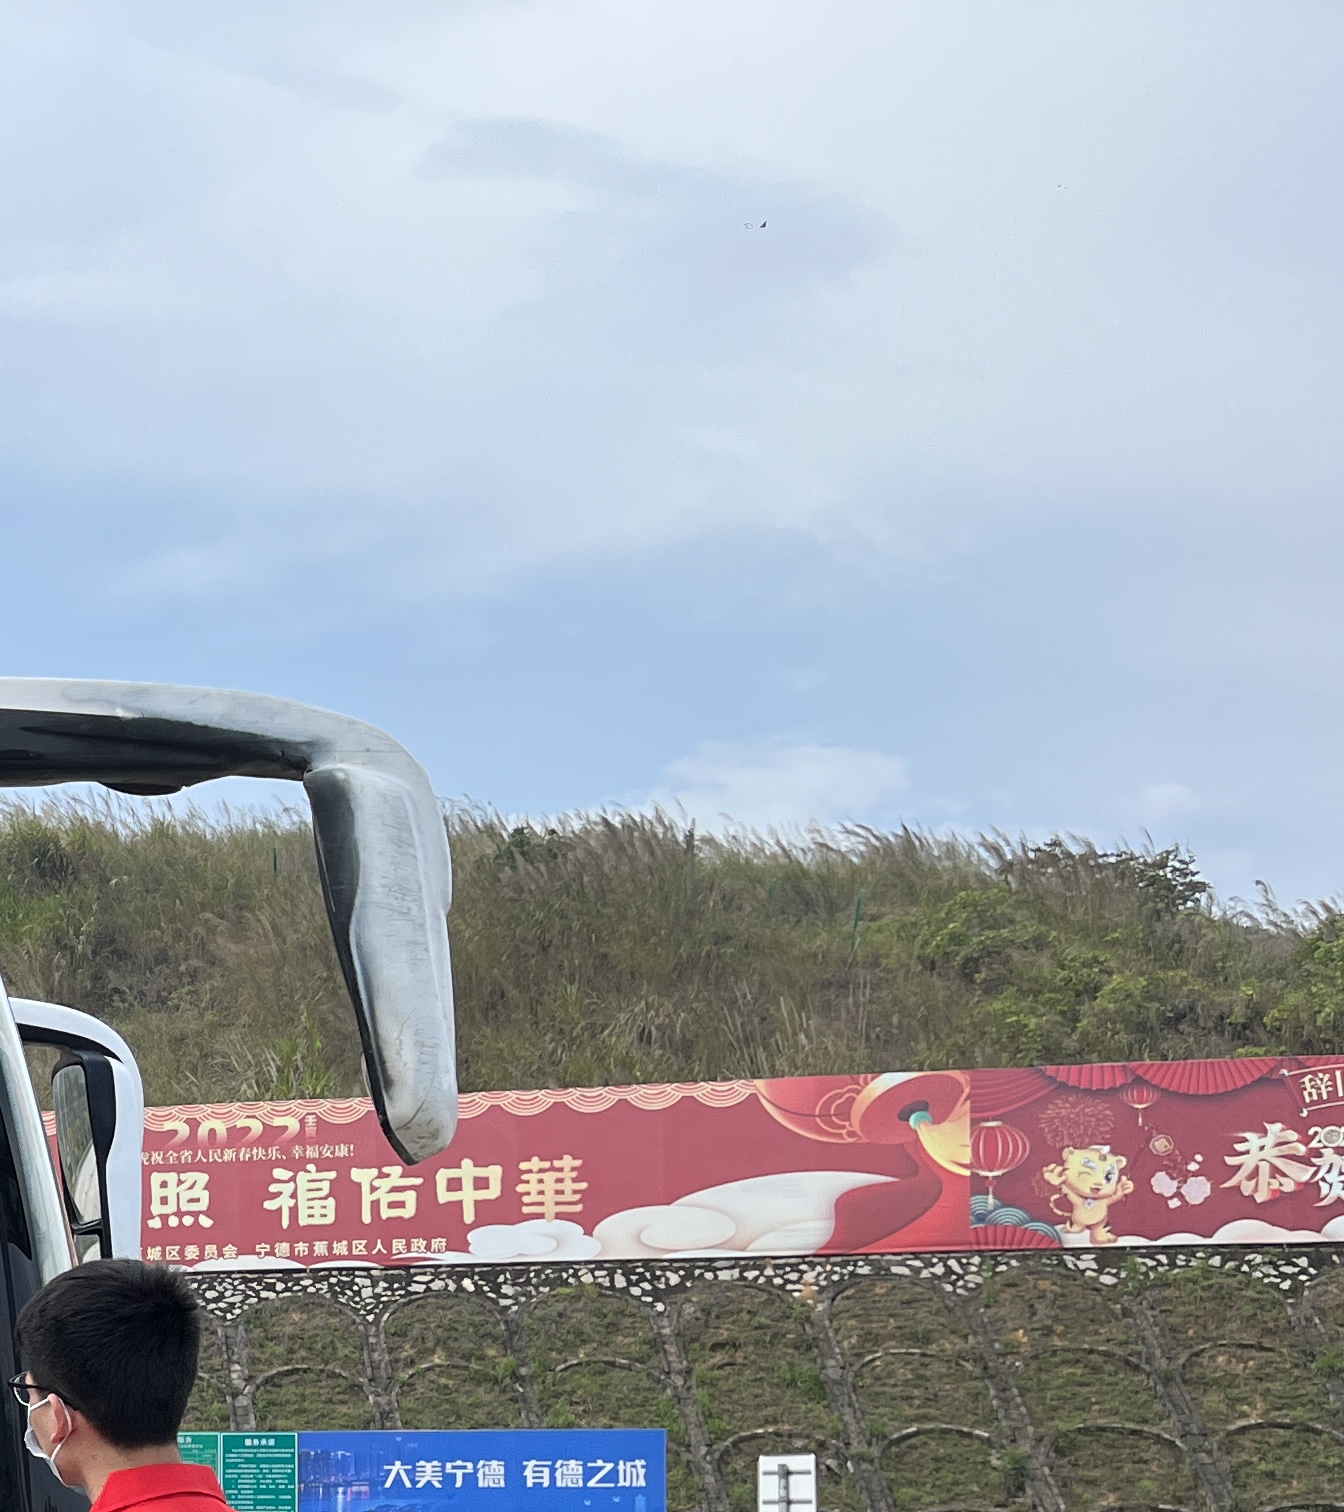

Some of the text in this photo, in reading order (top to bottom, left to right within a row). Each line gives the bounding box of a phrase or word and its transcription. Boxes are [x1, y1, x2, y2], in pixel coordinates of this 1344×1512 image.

[146, 1154, 589, 1230] 照 福佑中華
[140, 1237, 448, 1262] 城区委员会 宁德市蕉城区人民政府
[384, 1458, 648, 1489] 大美宁德 有德之城
